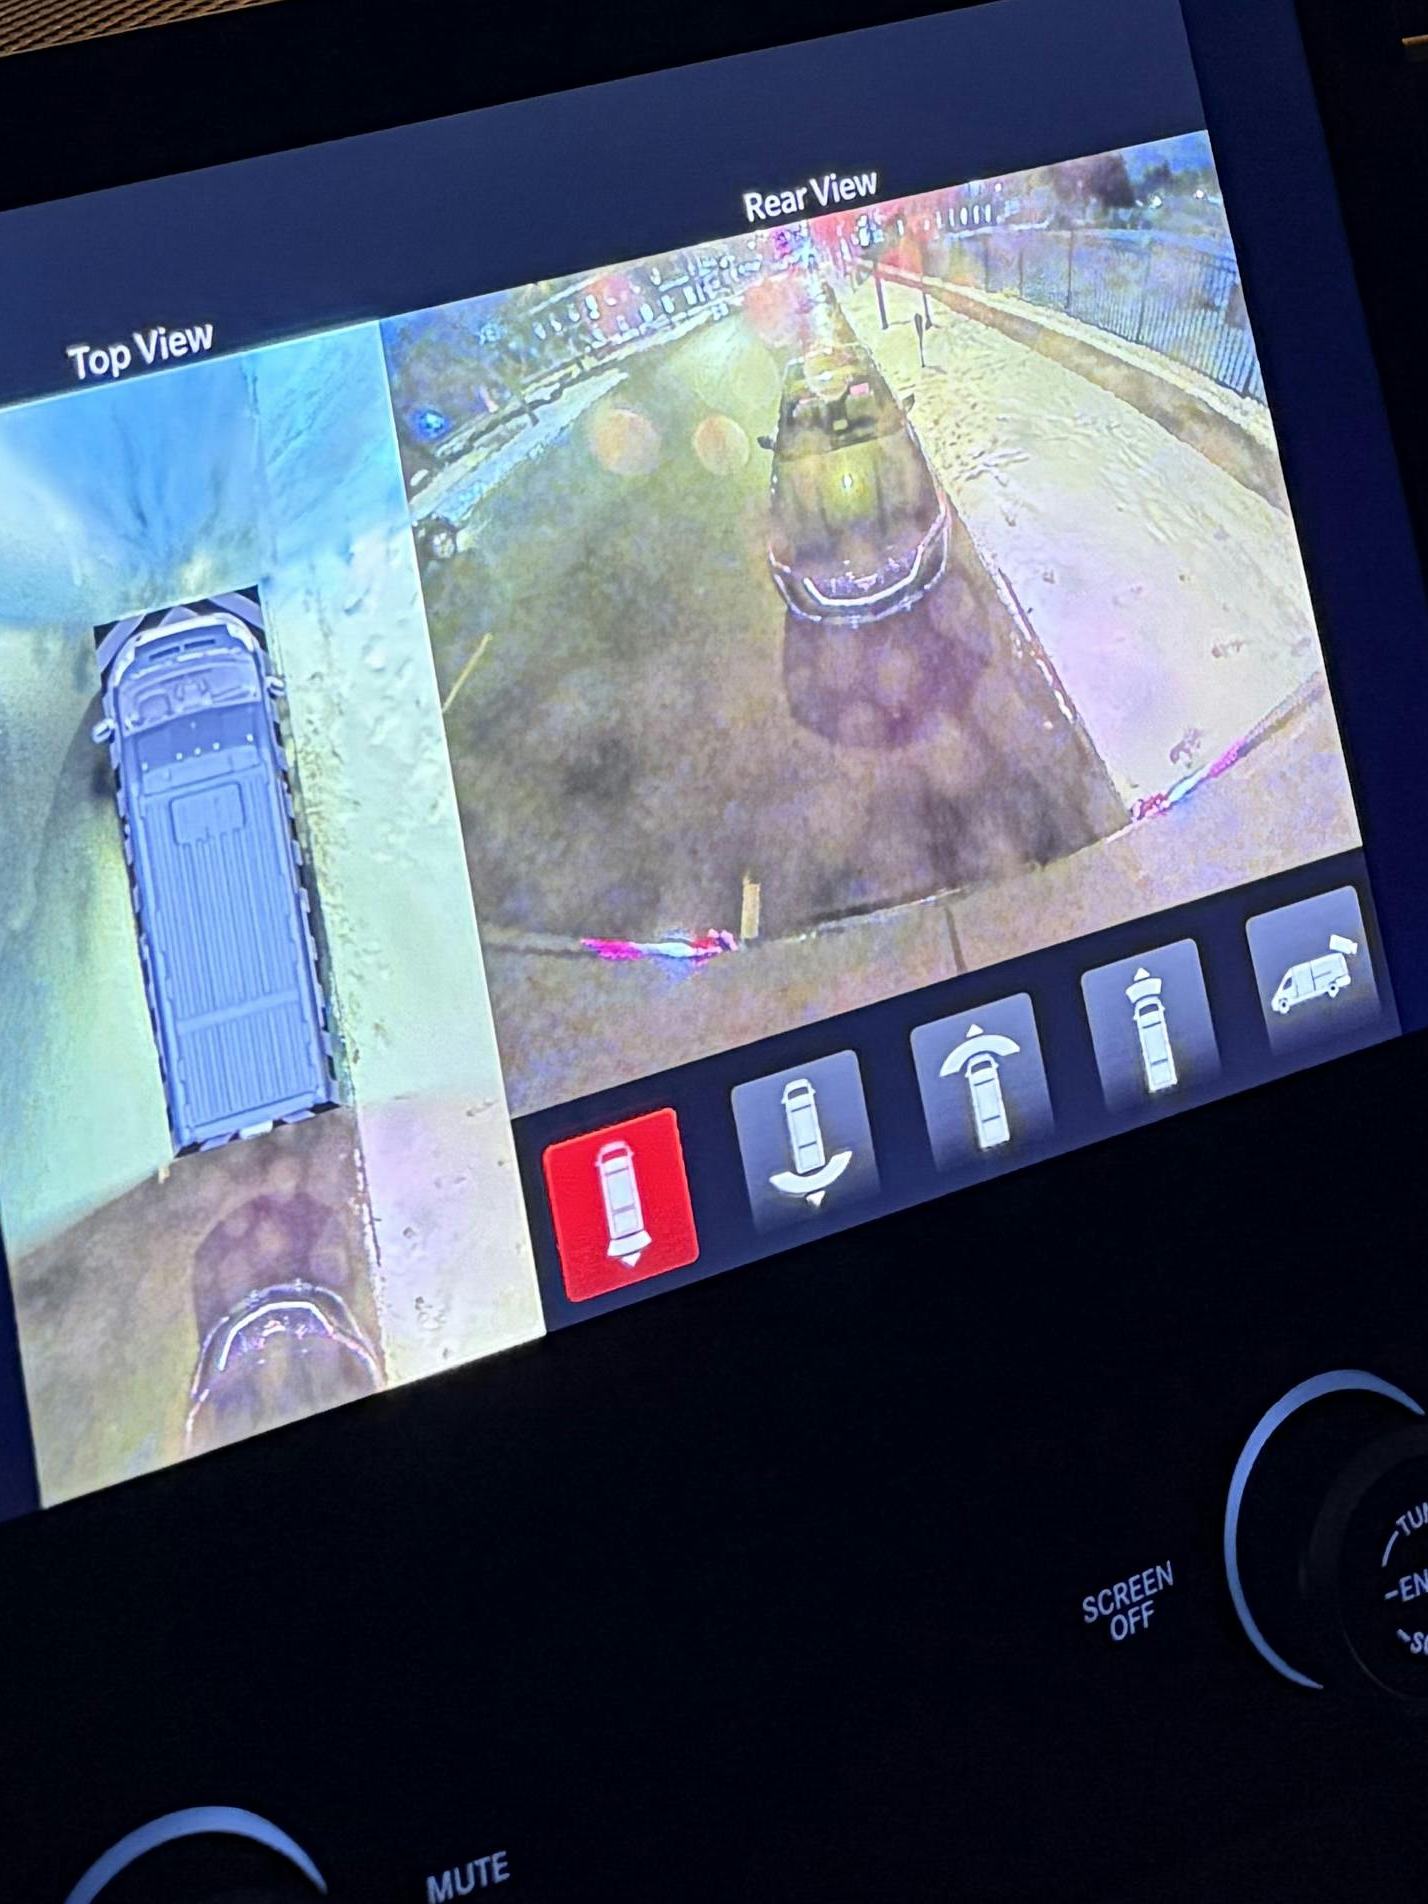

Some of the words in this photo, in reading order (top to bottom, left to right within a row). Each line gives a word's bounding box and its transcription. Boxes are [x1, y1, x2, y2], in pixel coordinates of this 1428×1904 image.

[743, 186, 808, 223] Rear
[808, 171, 878, 207] View
[65, 344, 132, 381] Top
[132, 323, 214, 365] View
[1082, 1559, 1174, 1624] SCREEN
[1110, 1599, 1155, 1642] OFF
[426, 1850, 511, 1904] MUTE
